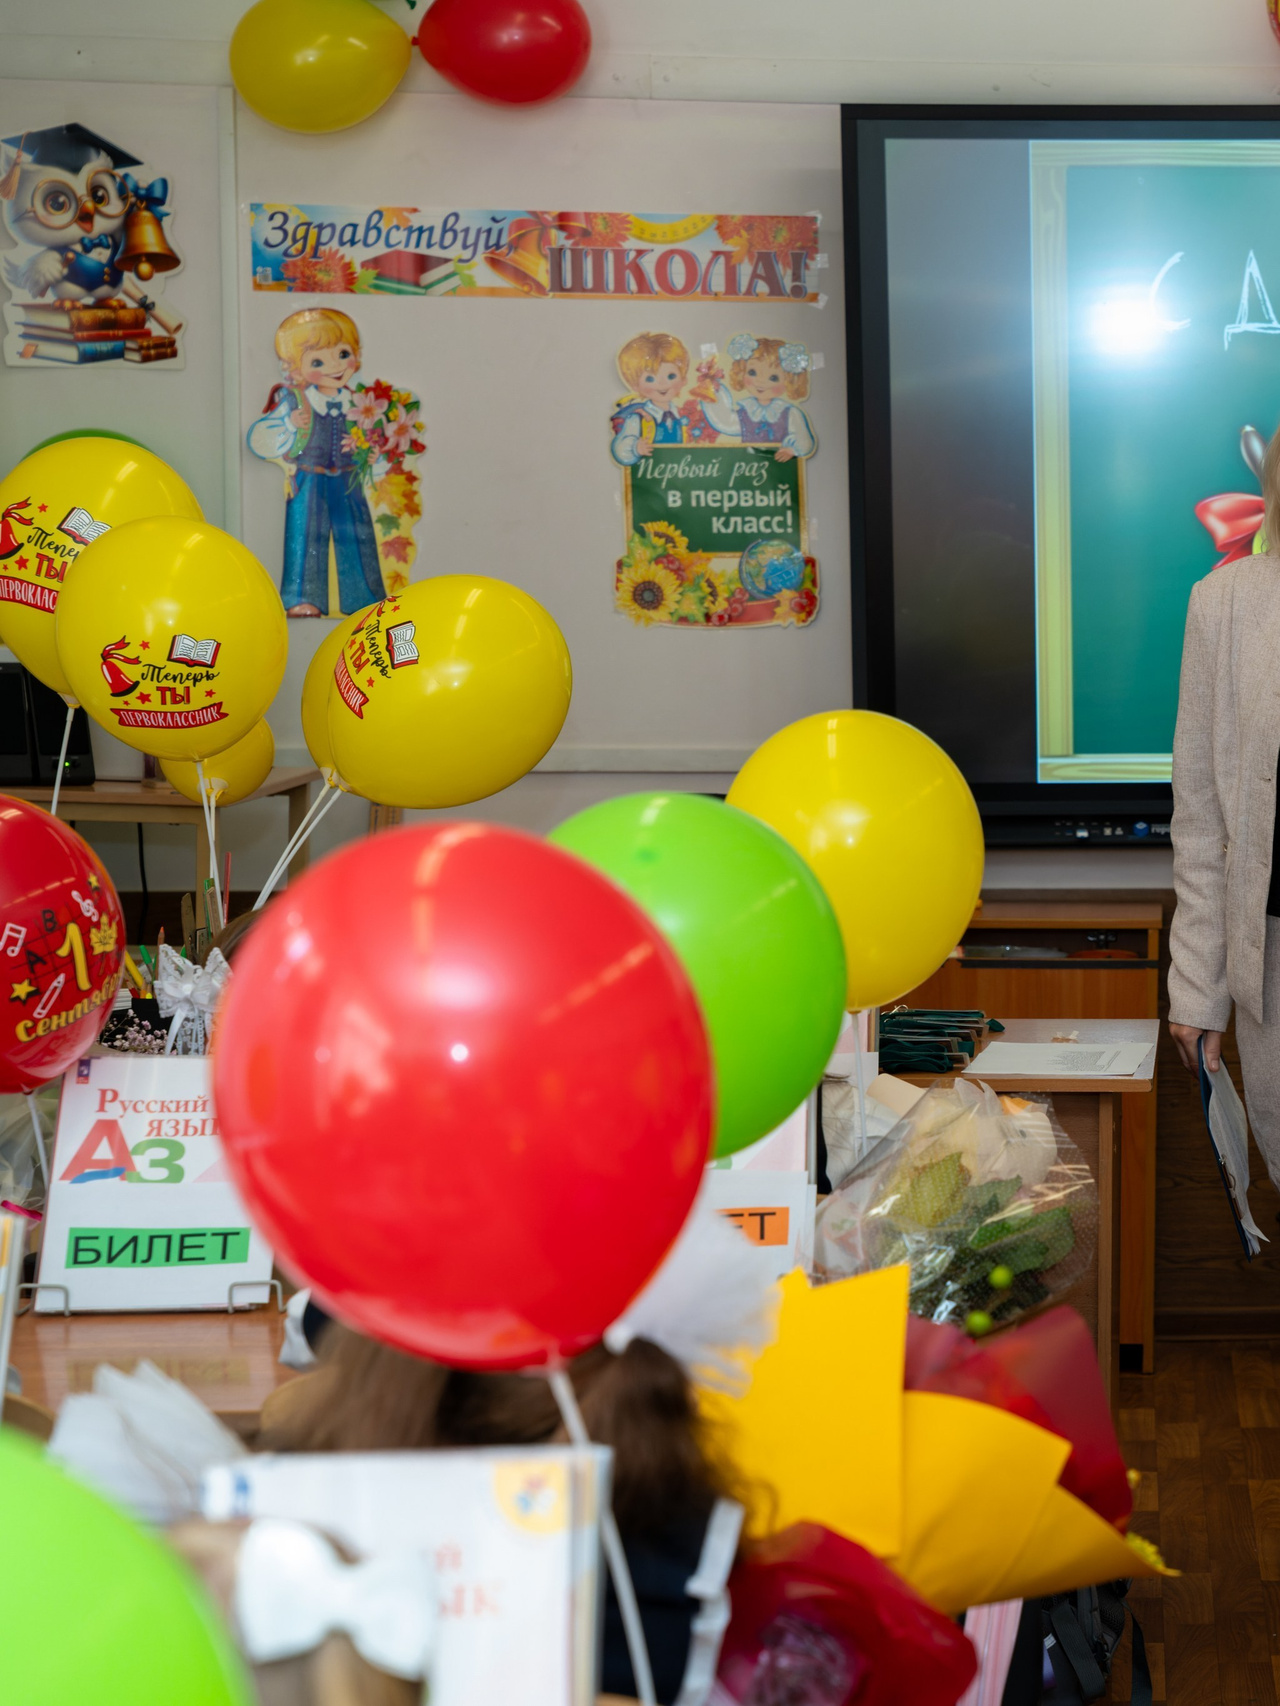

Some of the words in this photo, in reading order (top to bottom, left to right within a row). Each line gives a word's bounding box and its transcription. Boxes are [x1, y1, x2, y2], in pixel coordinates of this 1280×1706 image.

[263, 209, 514, 264] Здравствуй,
[547, 246, 809, 299] ШКОЛА!
[637, 454, 723, 490] Первый
[728, 460, 770, 488] раз
[667, 490, 683, 508] в
[690, 483, 793, 514] первый
[711, 509, 794, 534] класс!
[27, 526, 80, 564] Тепе
[35, 552, 69, 583] ТЫ
[0, 577, 58, 611] ПЕРВОКЛАС
[349, 640, 371, 675] ТЫ
[365, 618, 392, 679] Теперь
[140, 663, 221, 688] Теперь
[156, 685, 191, 706] ТЫ
[119, 705, 222, 728] ПЕРВОКЛАССНИК
[55, 921, 92, 991] 1
[95, 1087, 211, 1119] Русский
[58, 1118, 187, 1185] АЗ
[72, 1230, 241, 1266] БИЛЕТ
